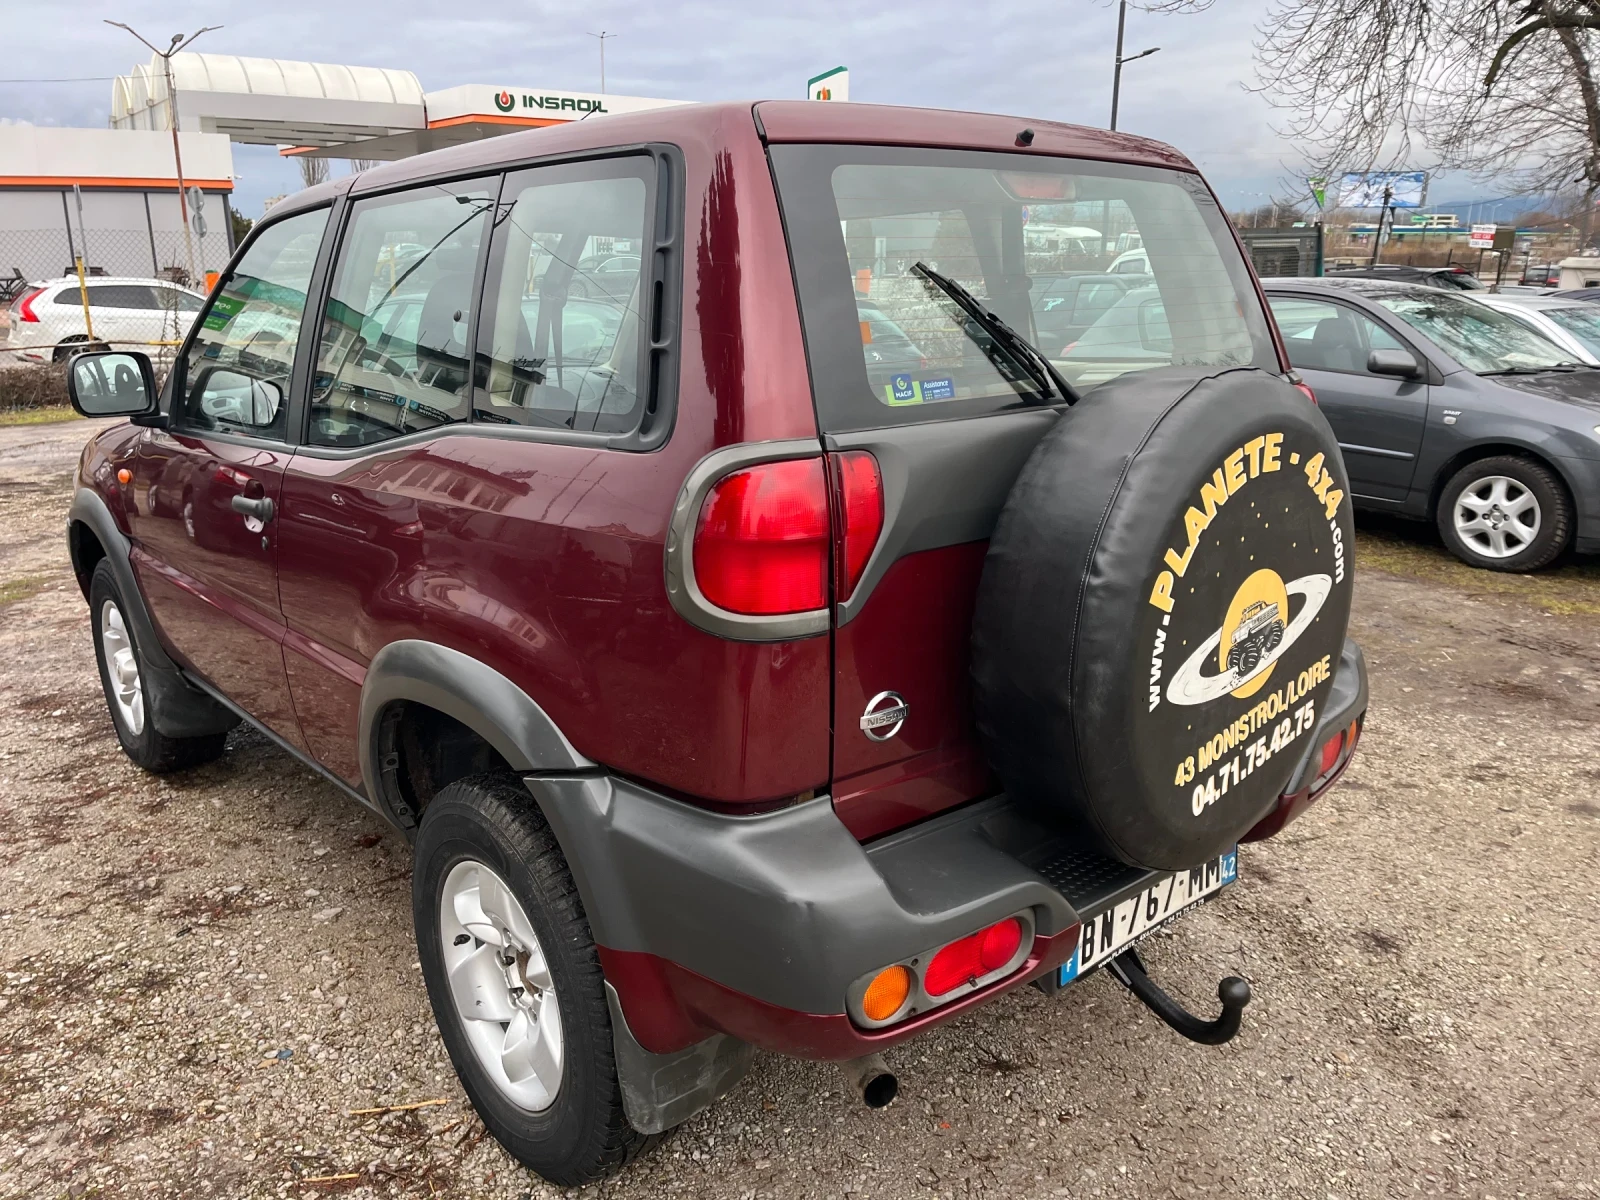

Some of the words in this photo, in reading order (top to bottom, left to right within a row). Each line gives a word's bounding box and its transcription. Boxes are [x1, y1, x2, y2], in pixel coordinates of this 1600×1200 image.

[522, 95, 608, 113] INSAOIL
[895, 390, 913, 398] MACIF
[923, 380, 949, 390] Assistance
[867, 708, 907, 727] NISSAN
[1174, 756, 1195, 787] 43
[1198, 654, 1331, 773] MONISTROL/LOIRE
[1192, 699, 1315, 817] 04.71.75.42.75
[1222, 856, 1236, 880] 42
[1065, 957, 1073, 973] F
